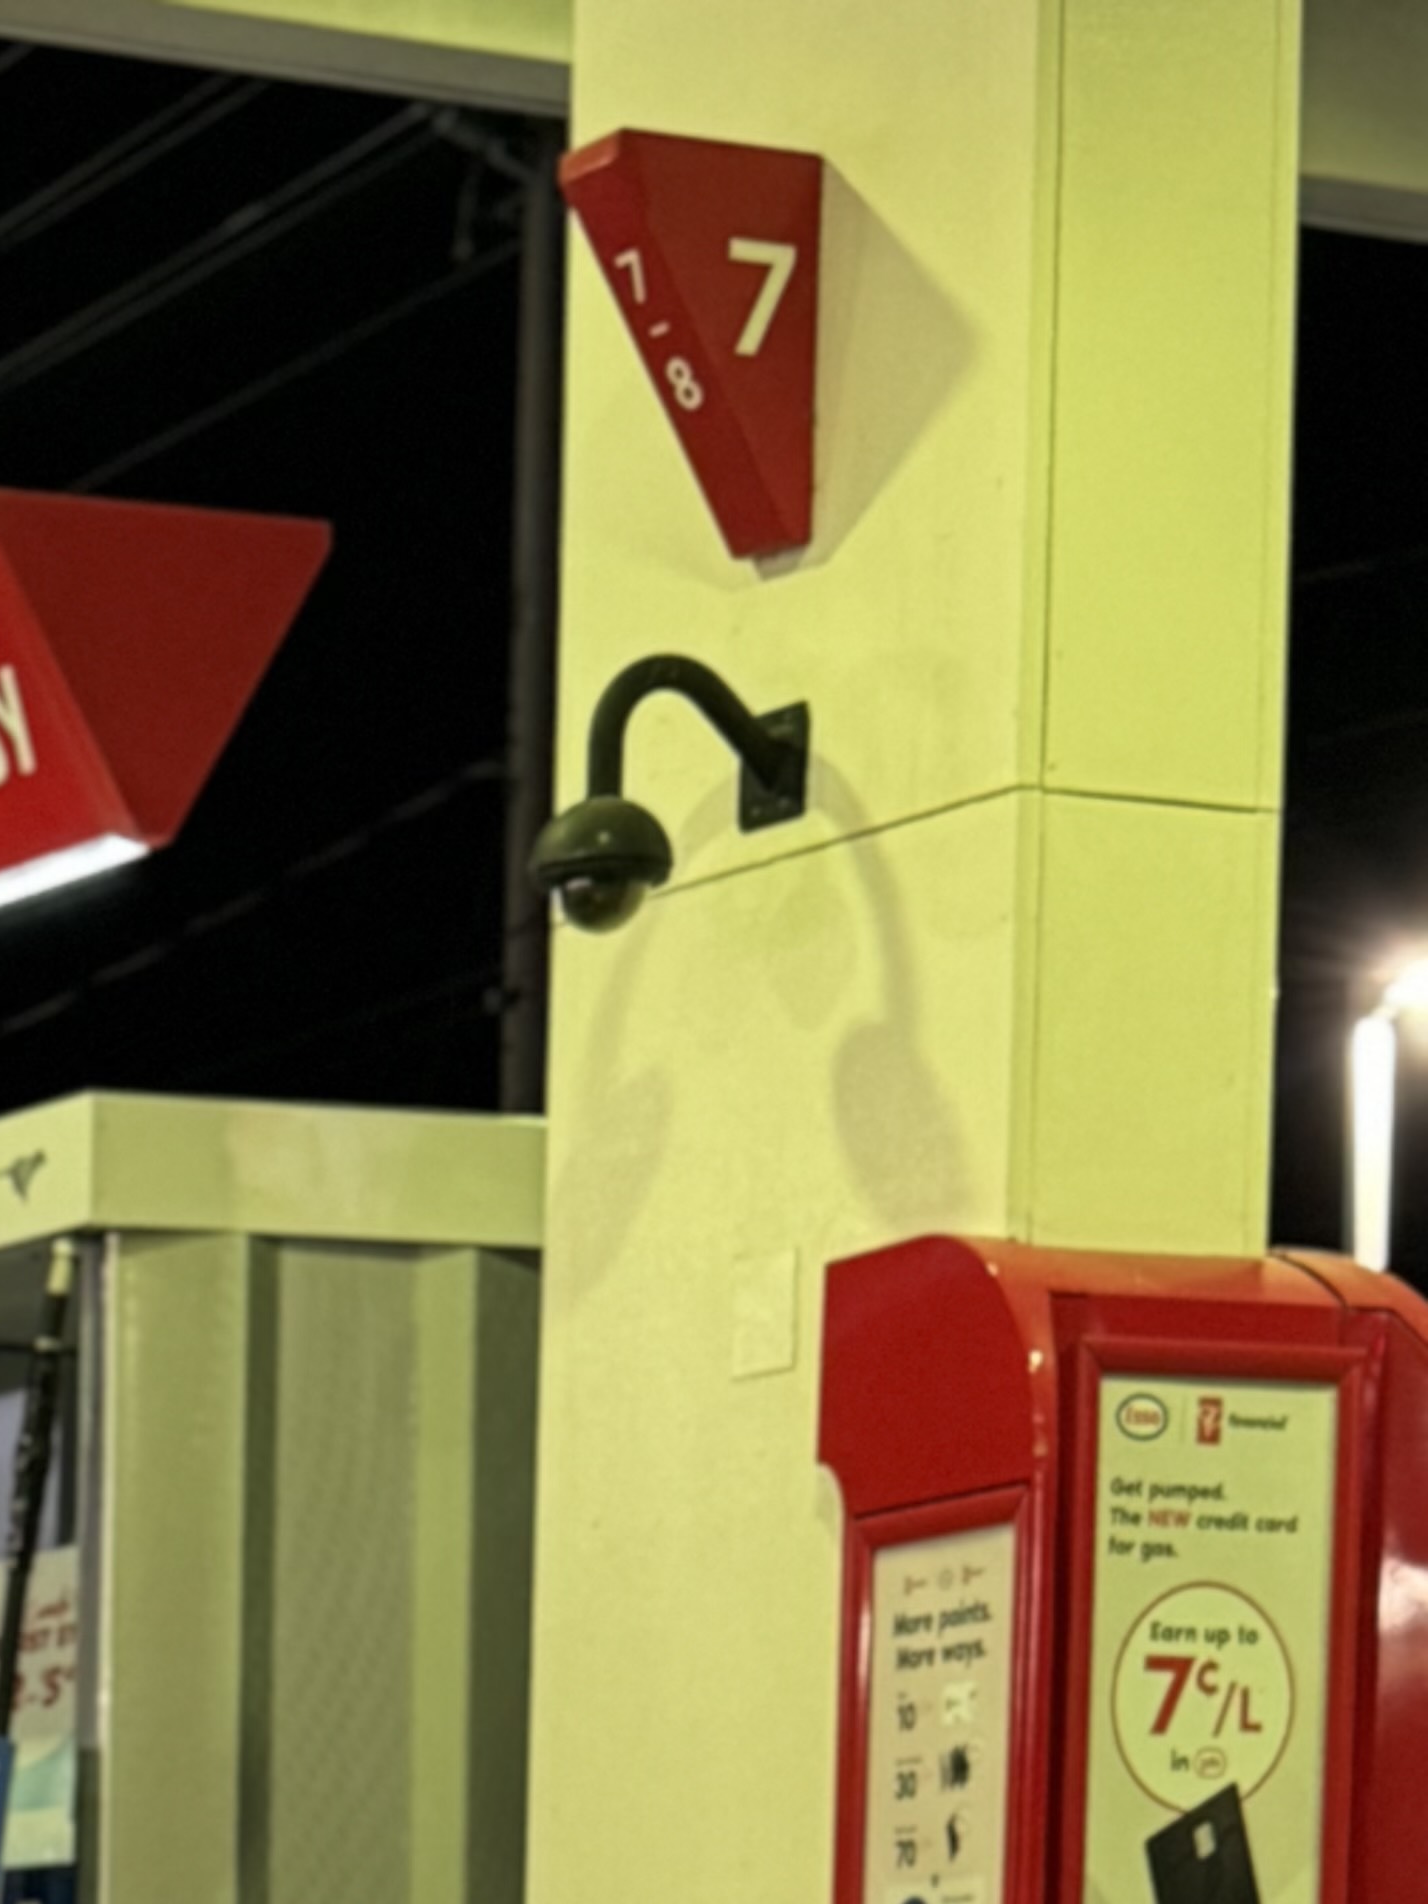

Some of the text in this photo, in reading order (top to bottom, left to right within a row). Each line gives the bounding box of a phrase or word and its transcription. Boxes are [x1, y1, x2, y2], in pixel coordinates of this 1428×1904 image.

[727, 236, 798, 357] 7
[1110, 1476, 1226, 1504] Get pumped.
[1110, 1506, 1299, 1534] The NEW credit card
[1108, 1536, 1178, 1564] for gas.
[894, 1611, 933, 1636] More
[1149, 1621, 1260, 1649] Earn up to
[896, 1647, 936, 1670] More
[897, 1701, 917, 1732] 10
[1170, 1749, 1190, 1771] in
[895, 1770, 918, 1801] 30
[895, 1837, 917, 1869] 70
